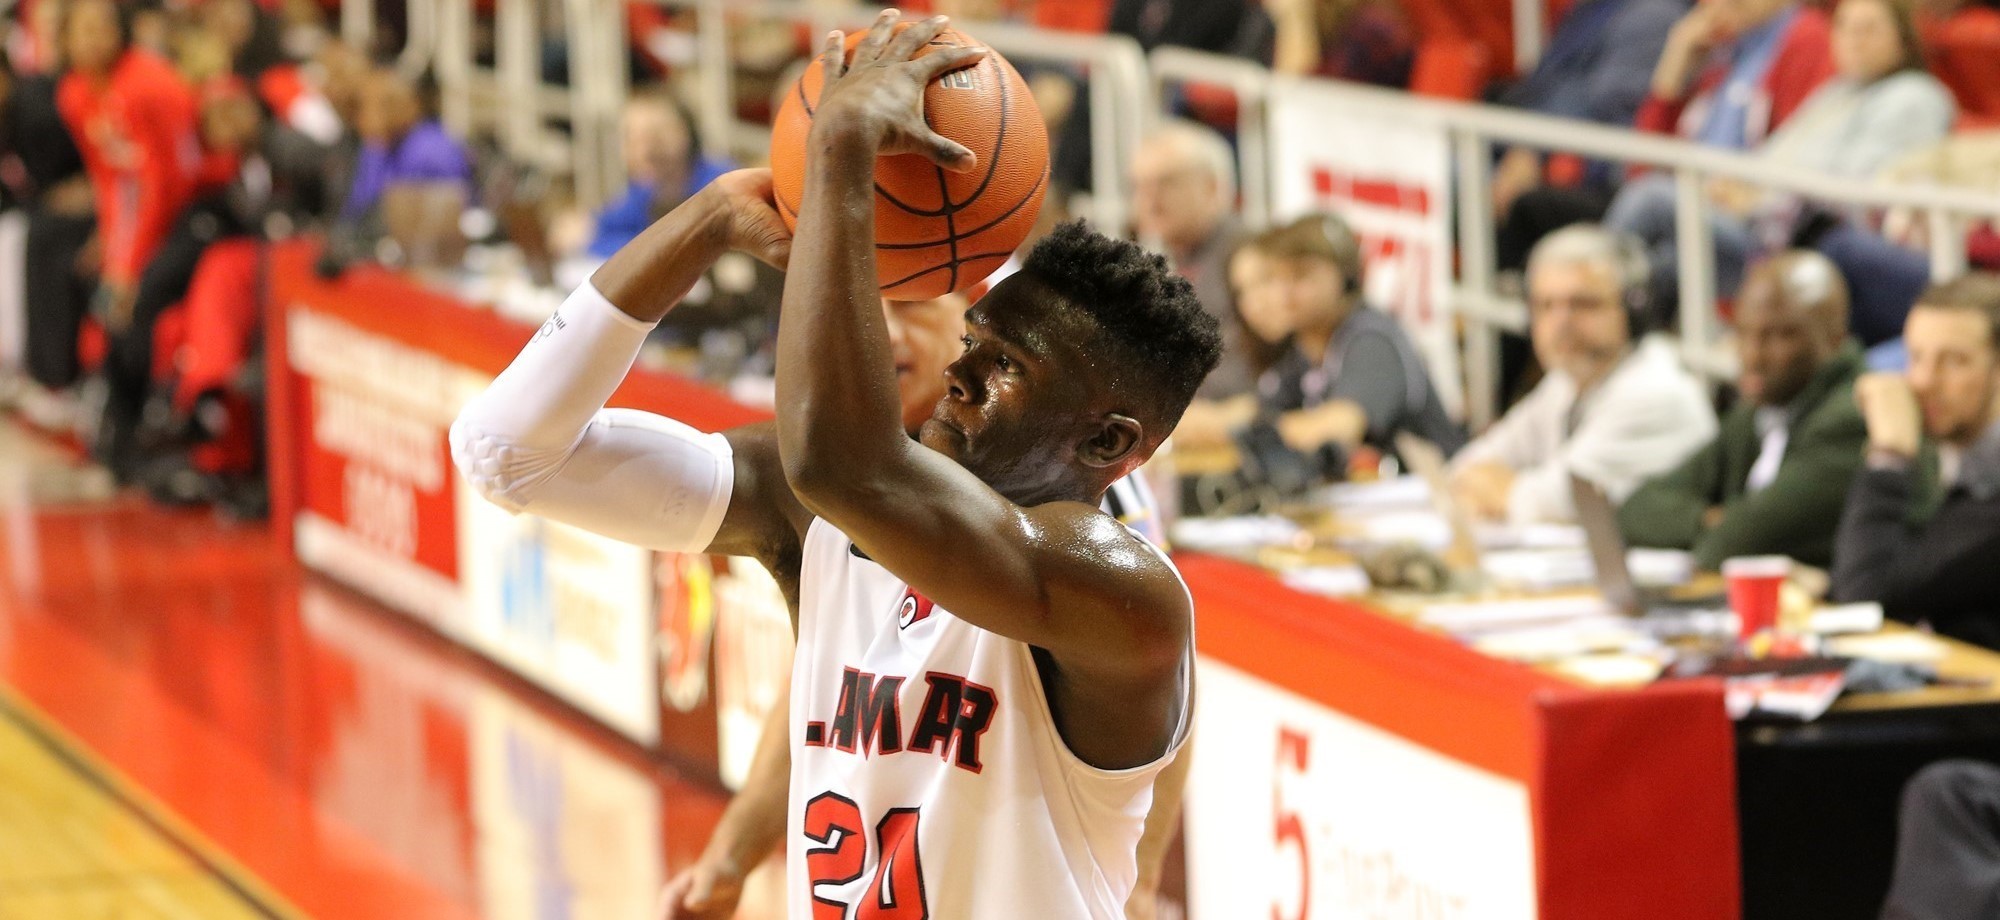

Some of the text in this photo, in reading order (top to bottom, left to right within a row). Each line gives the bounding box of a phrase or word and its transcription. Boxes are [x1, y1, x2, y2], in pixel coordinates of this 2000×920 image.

[805, 665, 999, 774] AMAR
[804, 790, 929, 919] 24
[1271, 727, 1312, 919] 5
